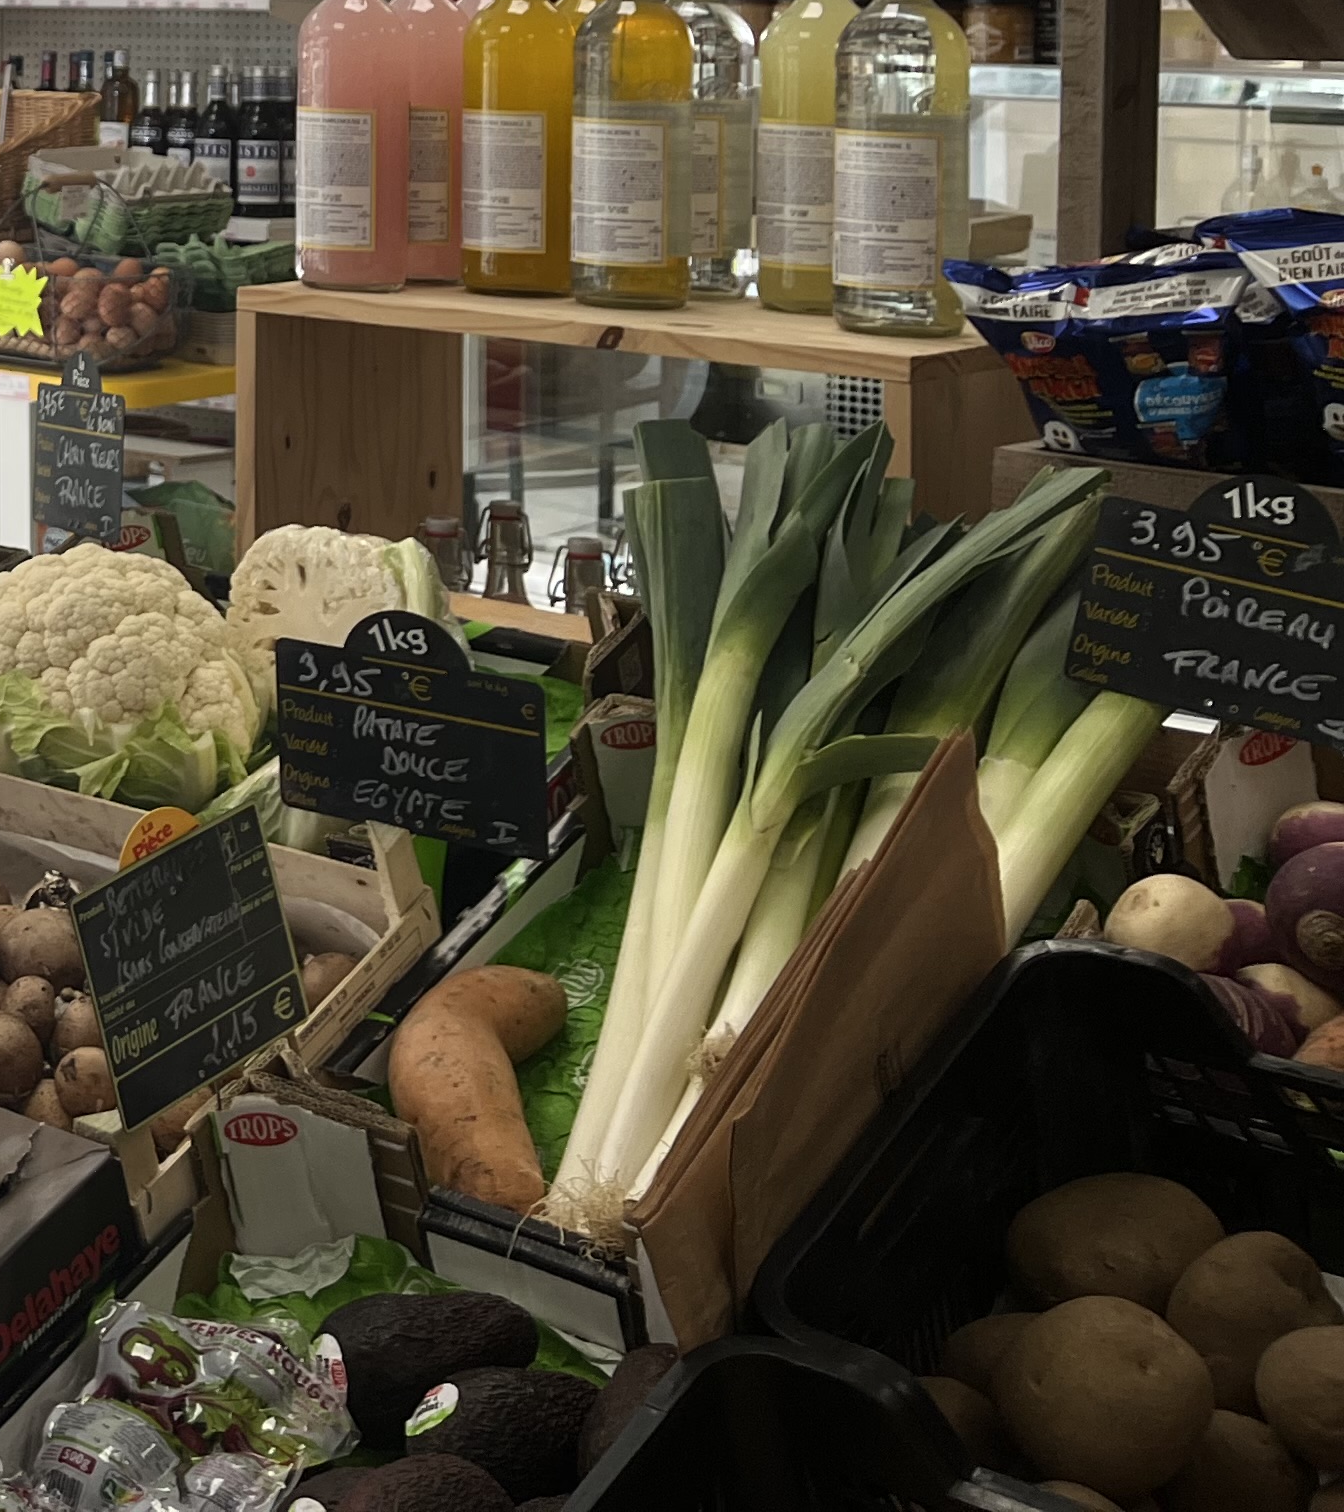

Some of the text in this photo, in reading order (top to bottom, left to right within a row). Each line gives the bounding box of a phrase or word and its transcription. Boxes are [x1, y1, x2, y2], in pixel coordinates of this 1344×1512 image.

[1291, 245, 1333, 264] GOÛT
[1223, 482, 1295, 526] 1kg
[1090, 564, 1155, 598] Produit
[368, 618, 429, 655] 1kg
[1073, 634, 1338, 701] Origine FRANCE
[408, 675, 432, 701] €
[281, 699, 447, 746] Produit PATATE
[380, 746, 470, 782] DOUCE
[353, 779, 472, 820] EGYPTE
[131, 822, 174, 861] Pièce
[164, 952, 256, 1030] FRANCE
[272, 986, 296, 1021] €
[112, 1017, 160, 1065] Origine
[226, 1115, 297, 1144] TROPS
